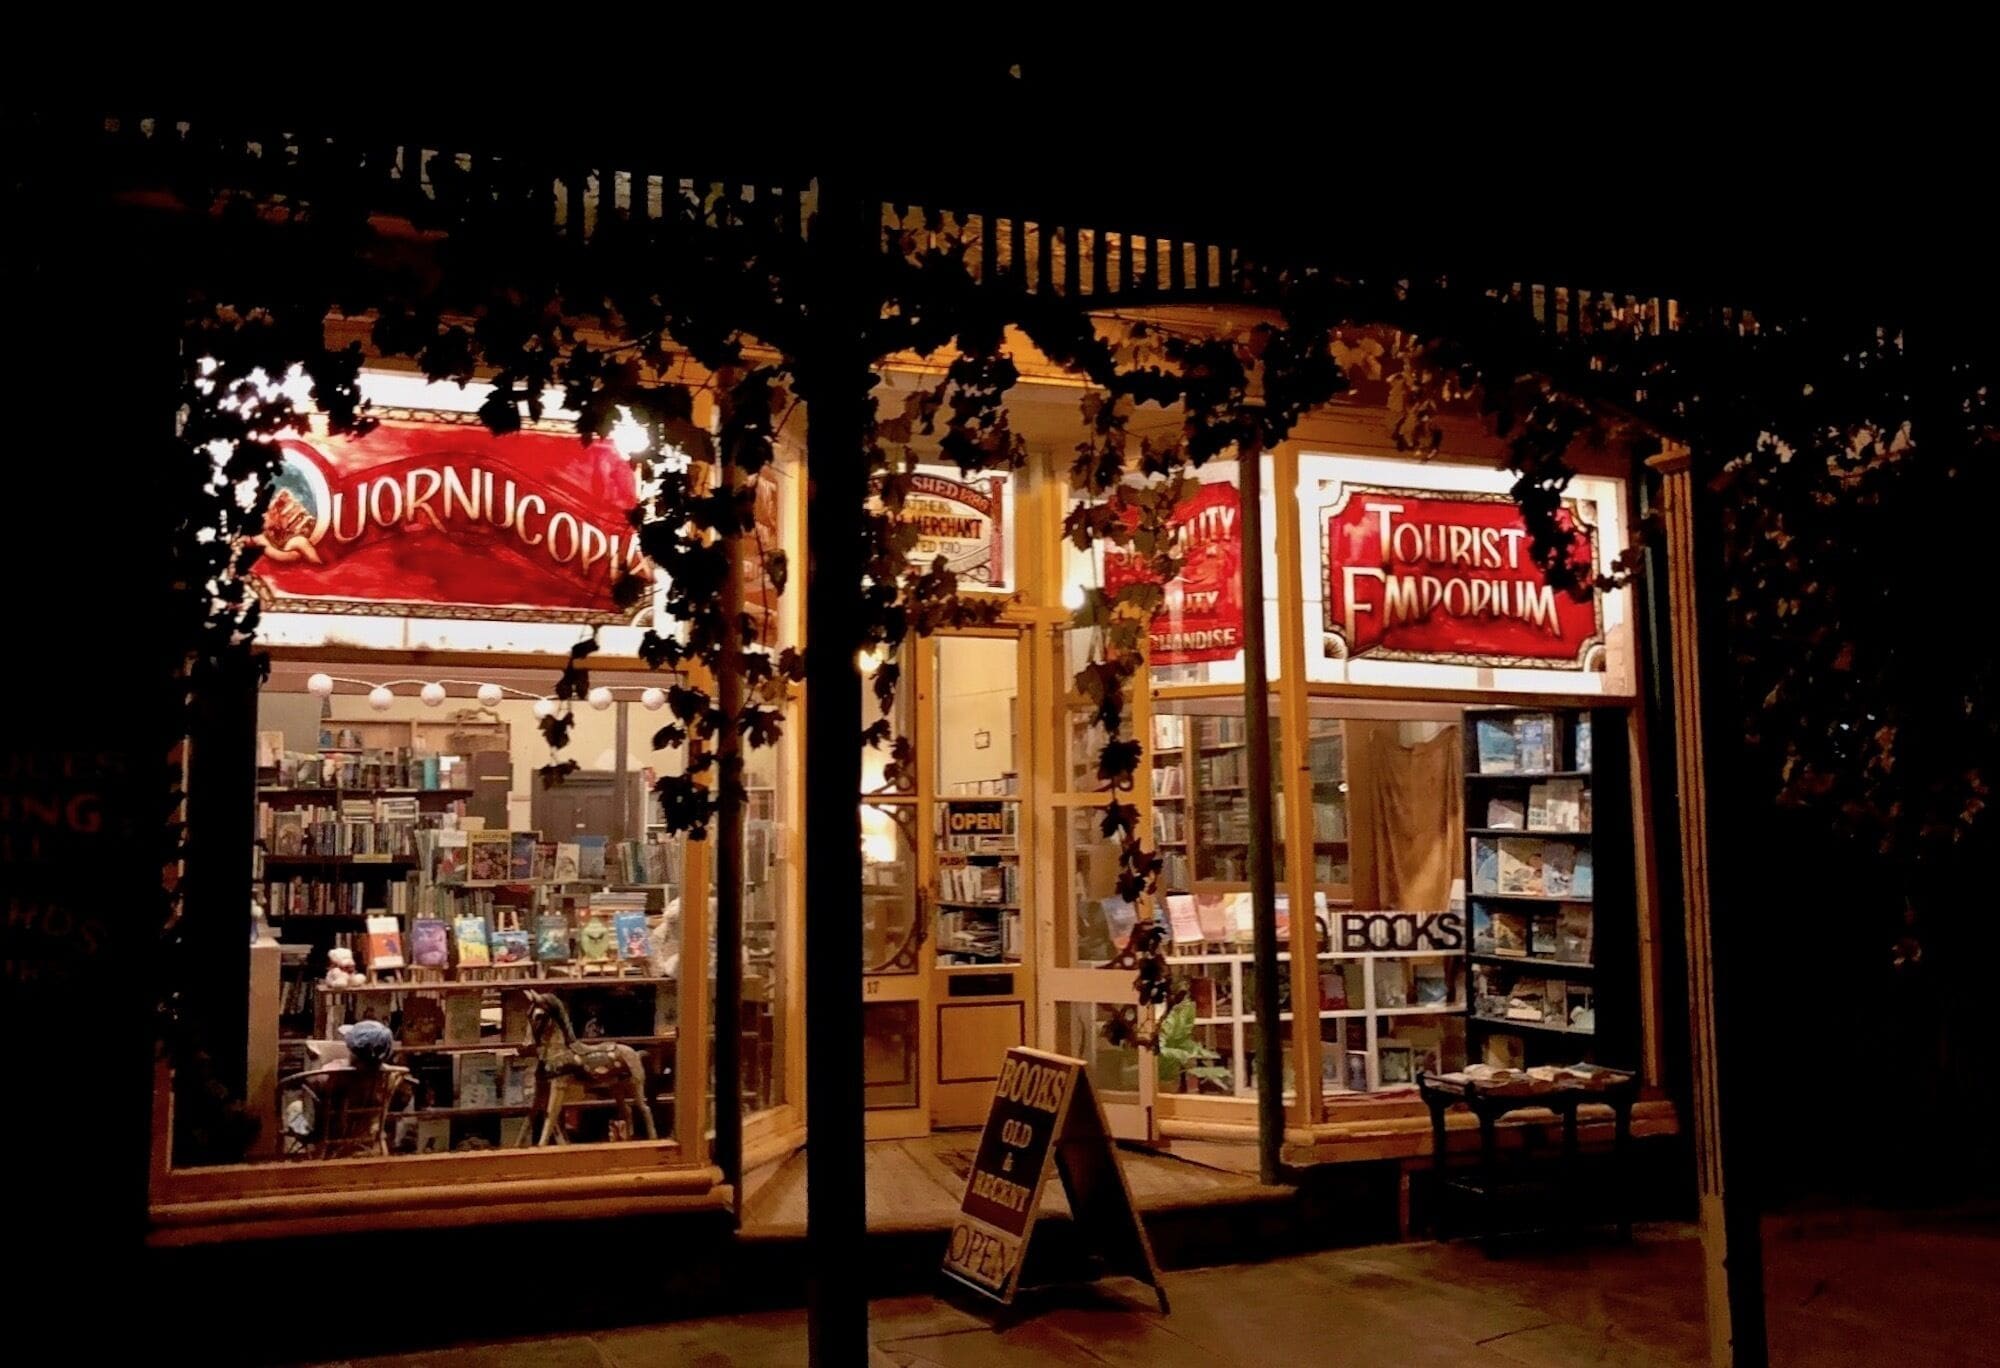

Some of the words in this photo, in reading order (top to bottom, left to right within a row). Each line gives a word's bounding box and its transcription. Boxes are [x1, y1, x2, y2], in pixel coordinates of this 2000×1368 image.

[1364, 502, 1526, 568] TOURIST
[1342, 565, 1561, 650] EMPORIUM
[951, 812, 1001, 831] OPEN
[1342, 912, 1463, 952] BOOKS
[998, 1057, 1069, 1114] BOOKS
[1001, 1118, 1033, 1148] OLD
[970, 1169, 1031, 1213] RECENT
[949, 1223, 1018, 1281] OPEN
